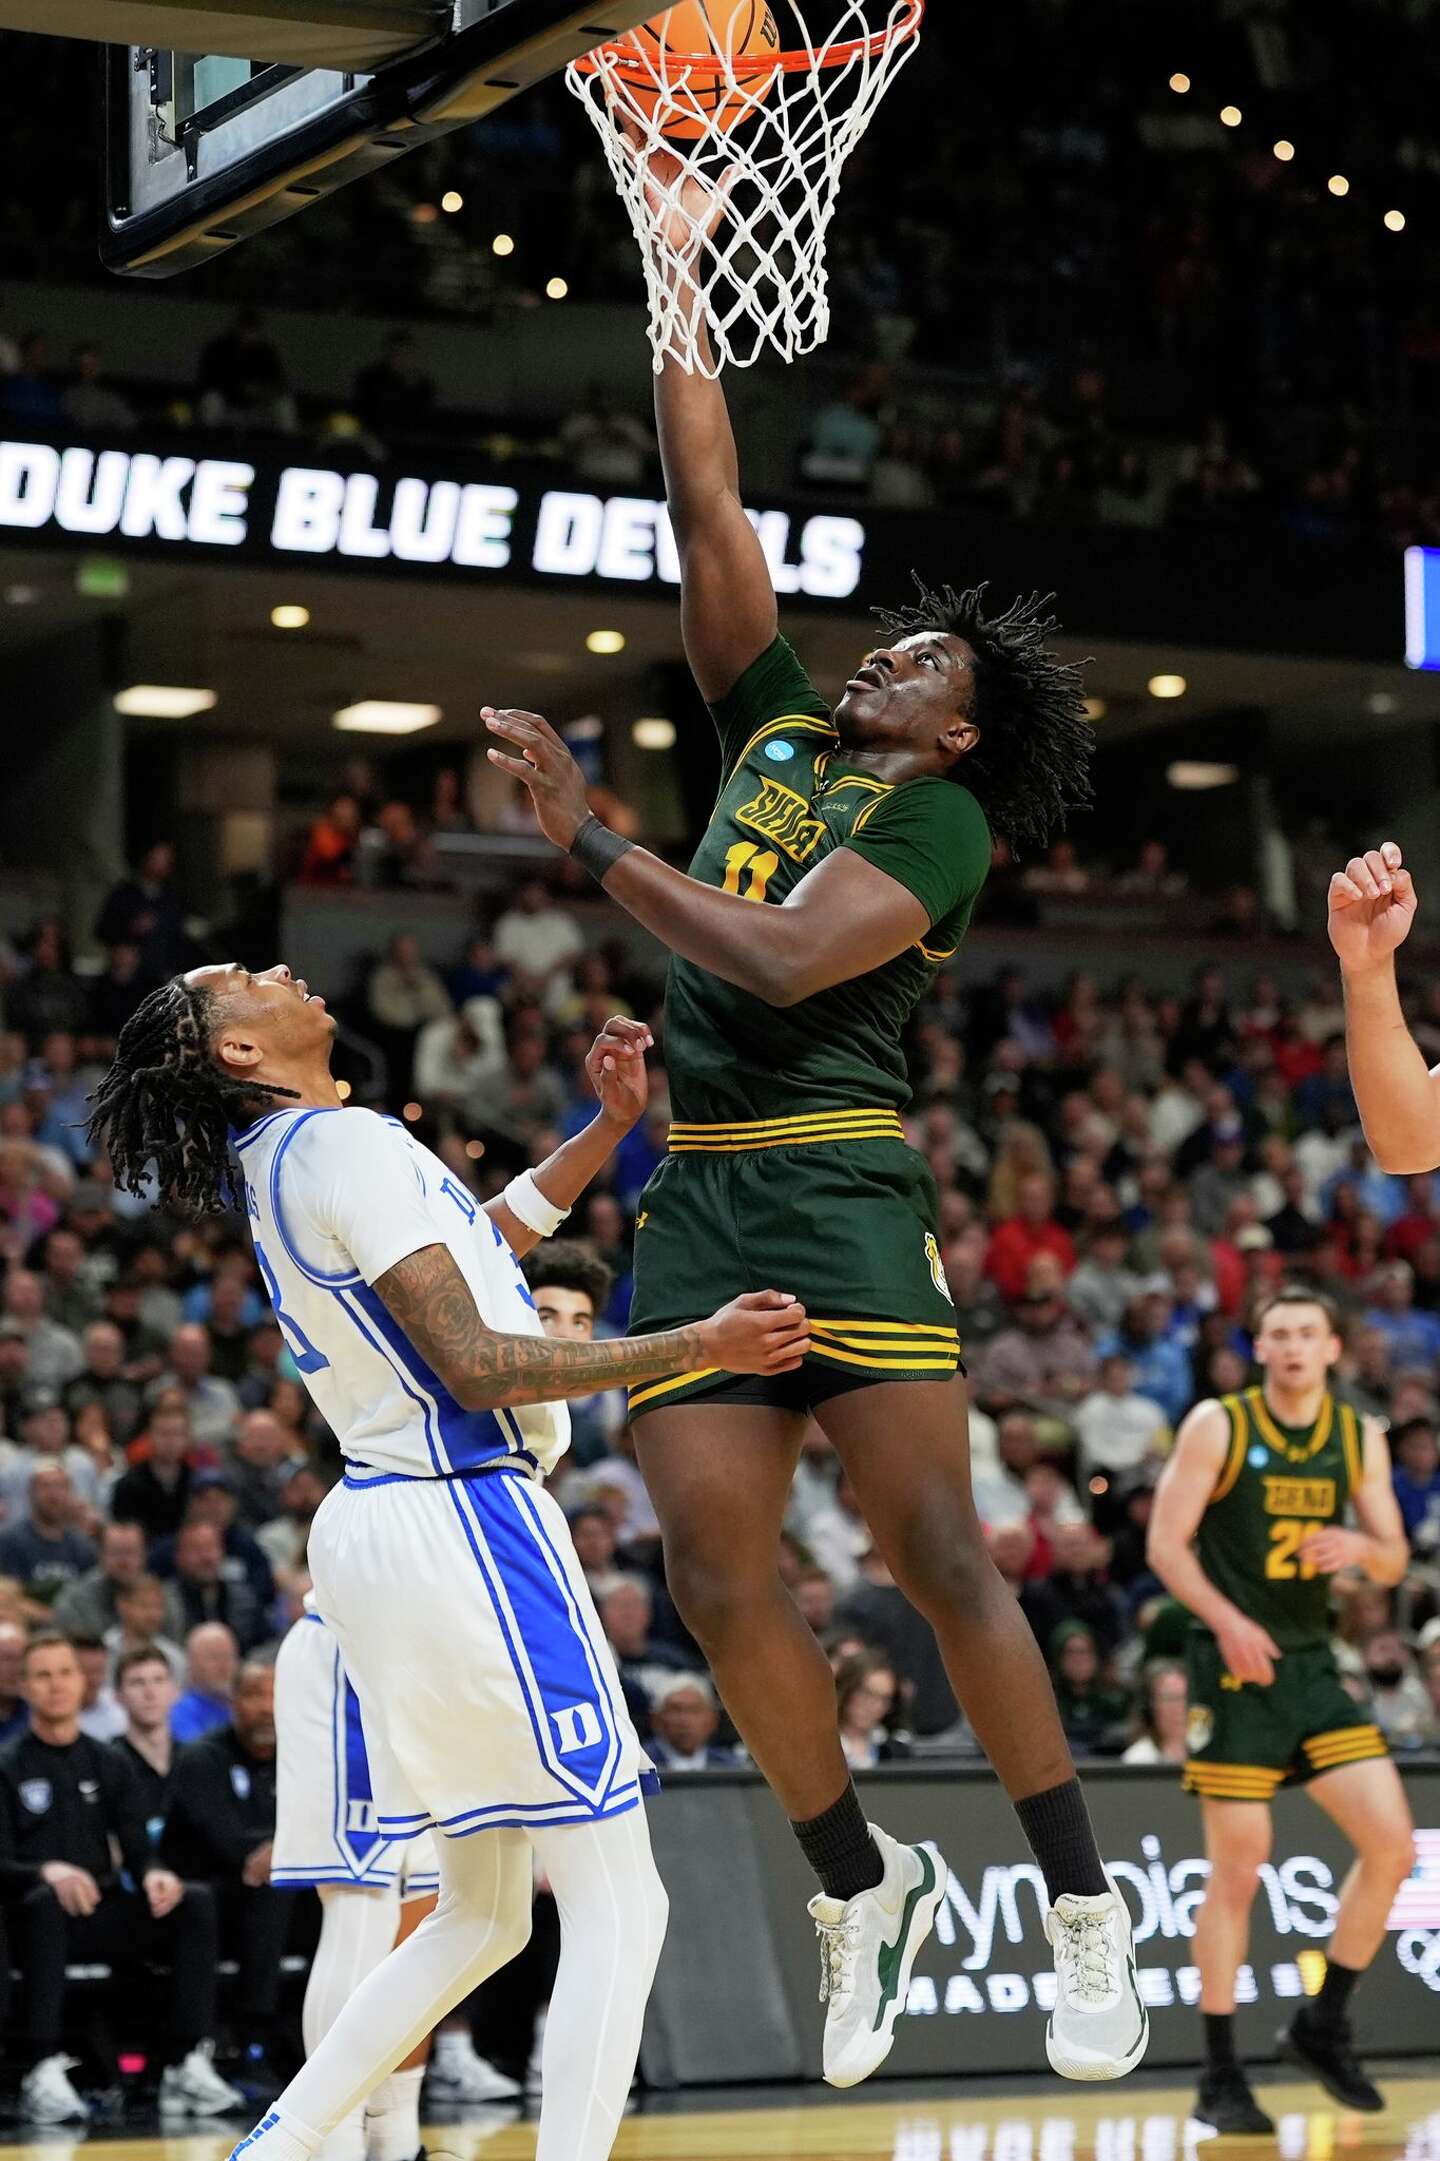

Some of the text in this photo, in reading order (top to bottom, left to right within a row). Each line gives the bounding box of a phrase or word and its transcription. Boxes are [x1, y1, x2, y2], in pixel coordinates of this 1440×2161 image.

[0, 441, 255, 546] DUKE
[271, 467, 518, 568] BLUE
[722, 841, 779, 903] 11
[550, 1702, 602, 1754] D
